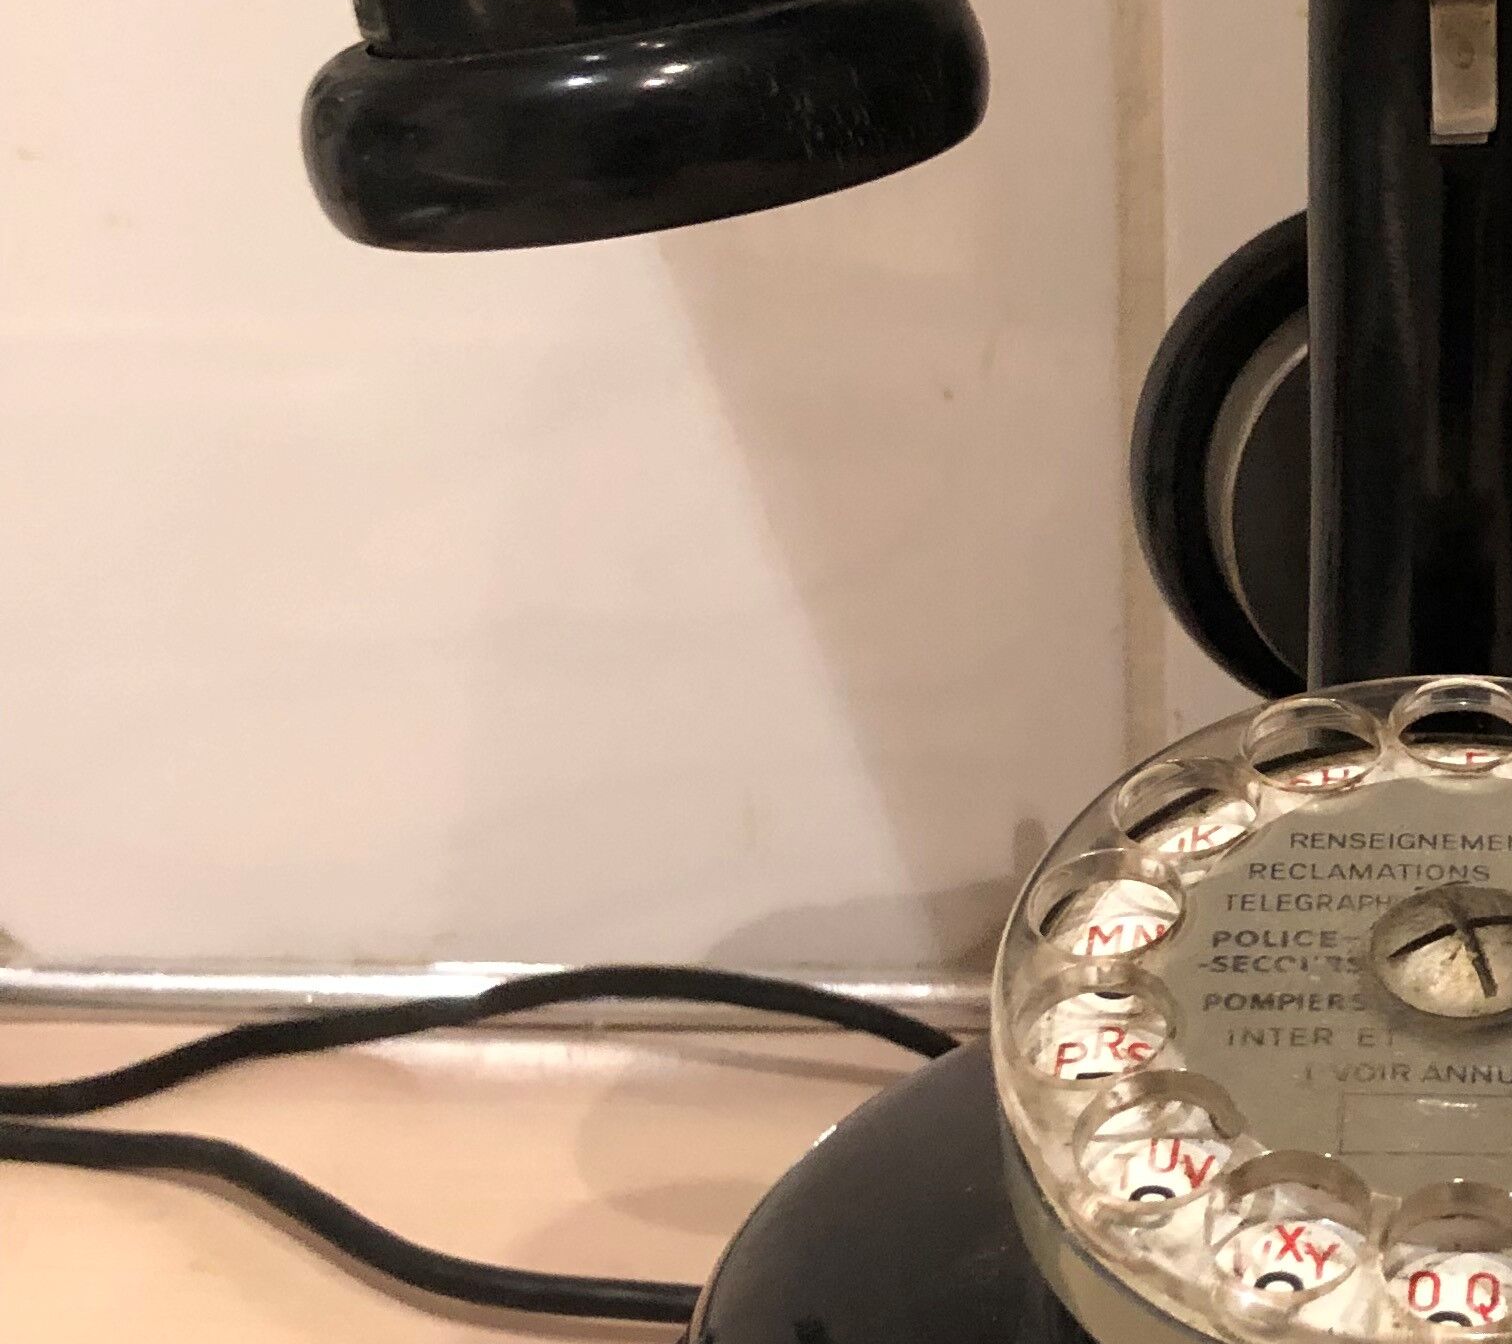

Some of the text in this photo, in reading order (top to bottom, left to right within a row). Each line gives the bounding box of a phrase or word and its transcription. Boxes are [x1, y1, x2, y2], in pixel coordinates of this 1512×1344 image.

[1249, 861, 1491, 882] RECLAMATIONS
[1226, 892, 1393, 912] TELEGRAPH
[1201, 992, 1369, 1012] POMPIERS
[1227, 1026, 1333, 1047] INTER
[1261, 1224, 1340, 1279] XY
